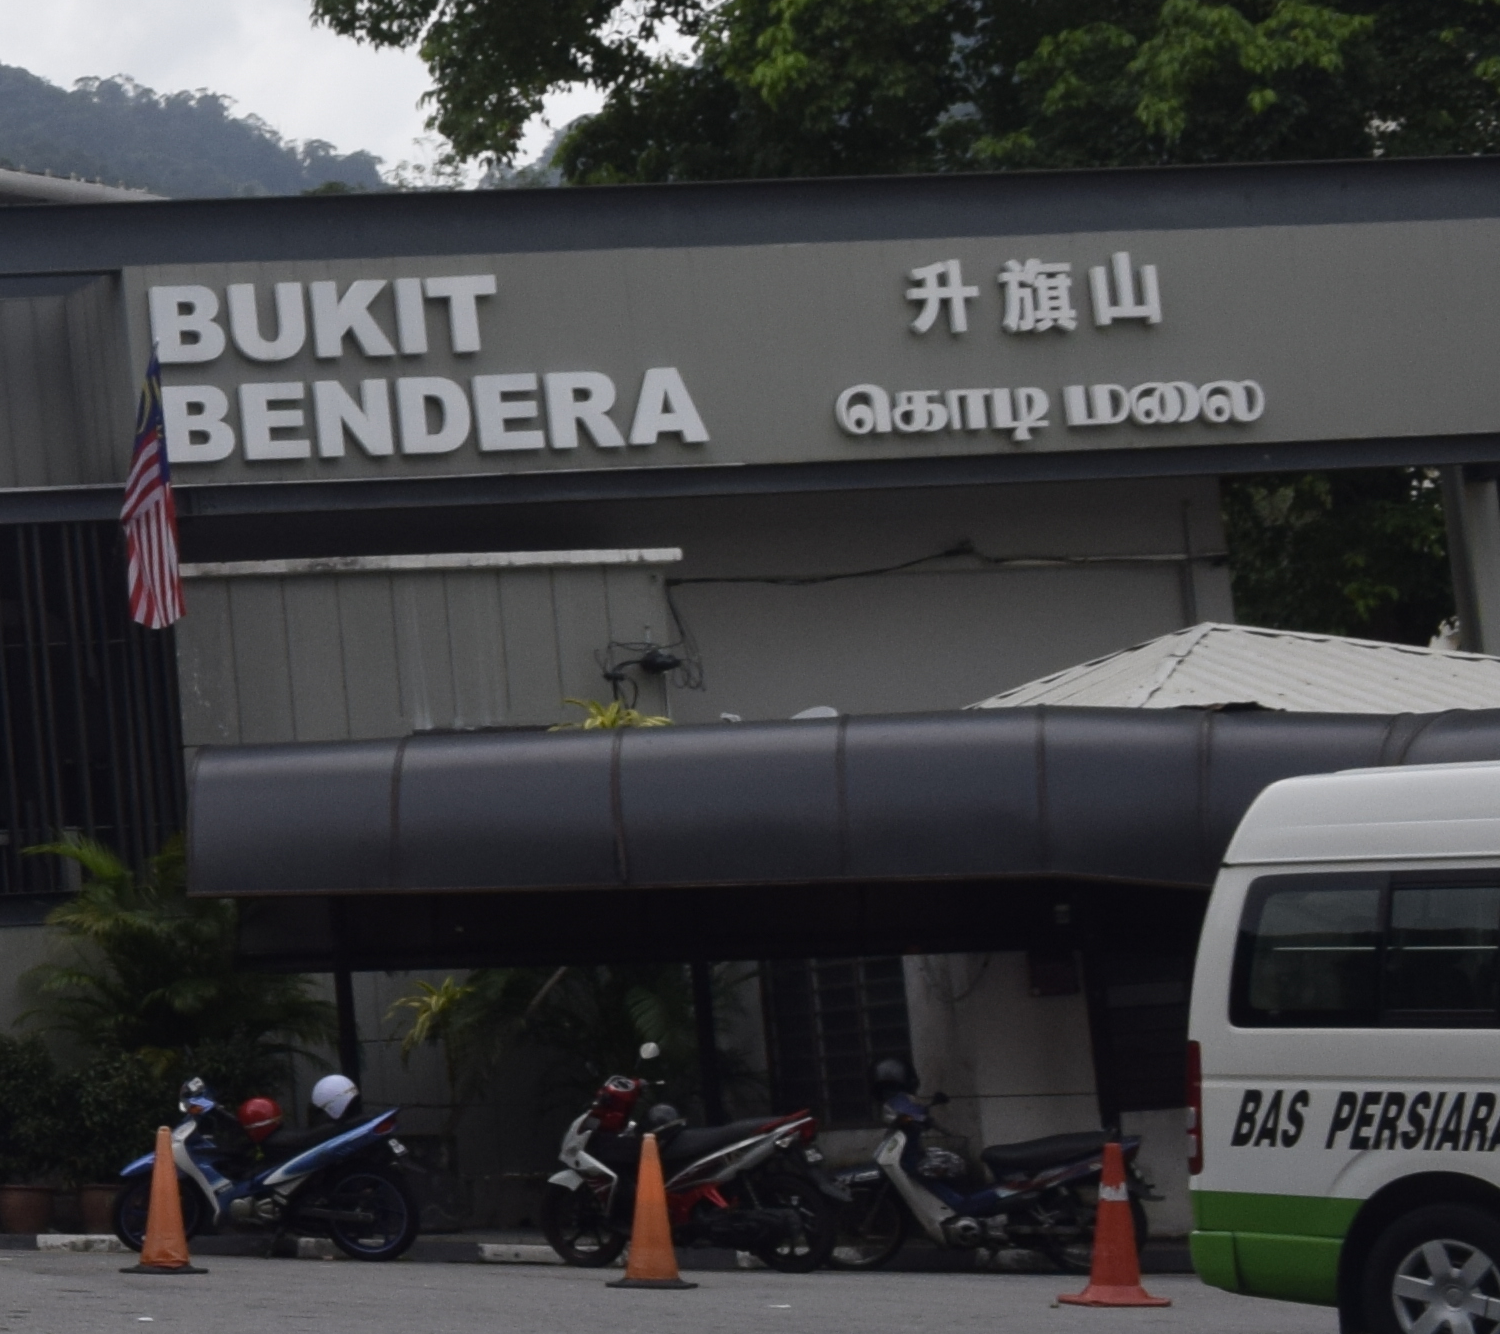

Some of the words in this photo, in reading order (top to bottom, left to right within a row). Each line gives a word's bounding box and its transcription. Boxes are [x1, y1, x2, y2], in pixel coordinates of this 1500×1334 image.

[147, 273, 498, 365] BUKIT
[904, 250, 1163, 335] 升旗山
[159, 366, 711, 465] BENDERA
[835, 383, 1052, 443] கொடி
[1063, 378, 1267, 430] மலை
[1230, 1089, 1311, 1149] BAS
